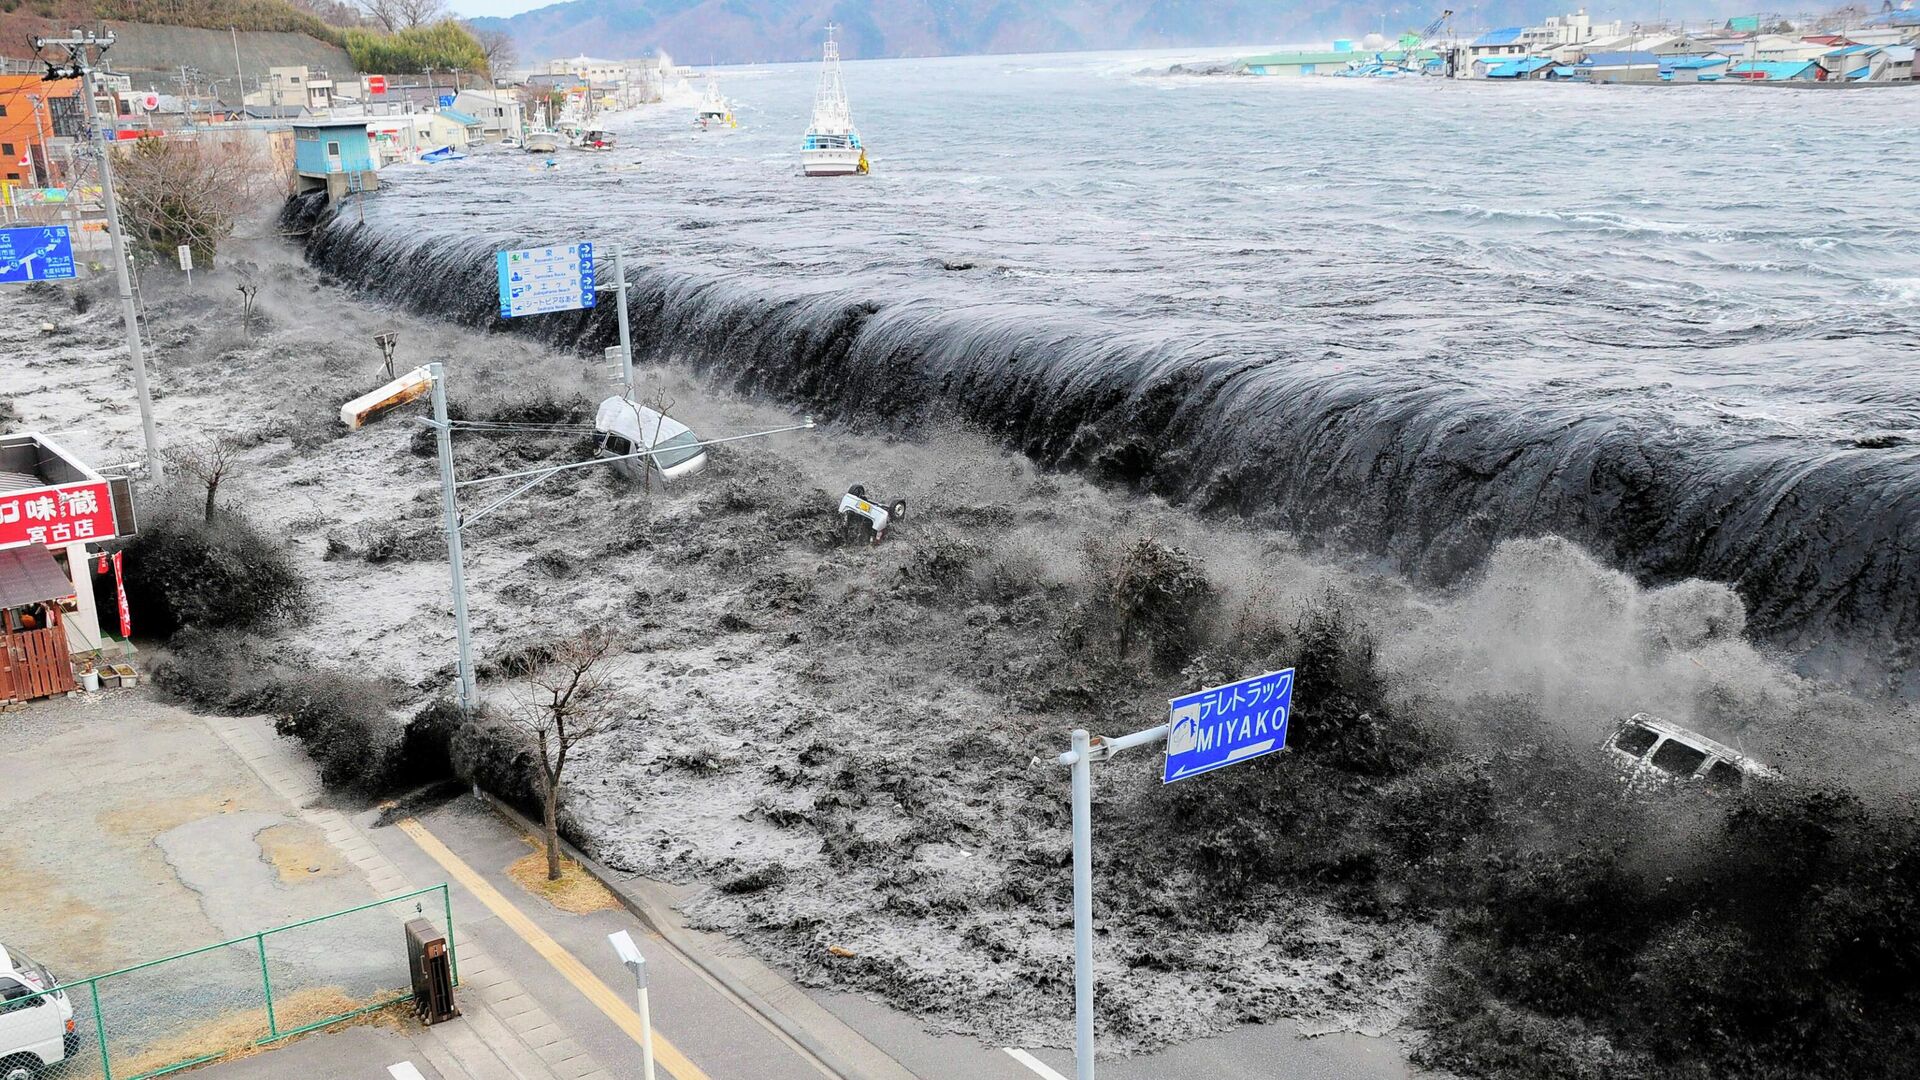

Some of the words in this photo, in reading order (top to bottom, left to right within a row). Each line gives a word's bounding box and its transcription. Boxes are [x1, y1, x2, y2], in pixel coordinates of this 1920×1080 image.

[26, 519, 95, 543] 宮古店
[1201, 674, 1291, 720] テレトラック
[1196, 706, 1286, 753] MIYAKO
